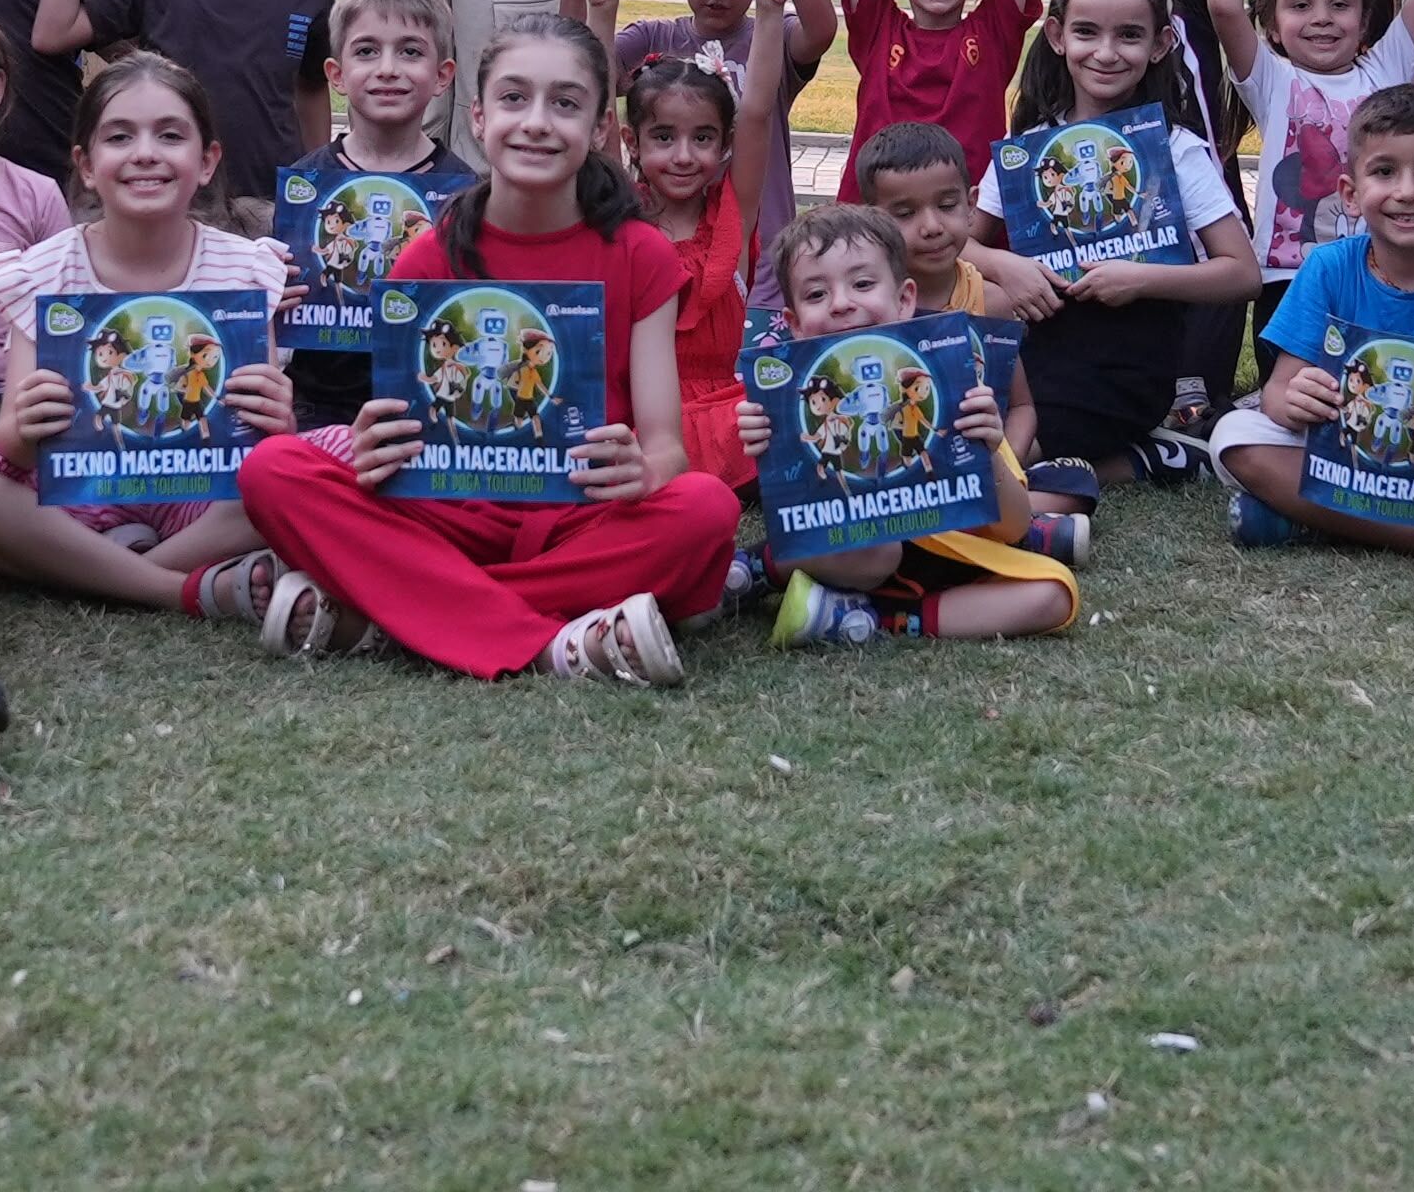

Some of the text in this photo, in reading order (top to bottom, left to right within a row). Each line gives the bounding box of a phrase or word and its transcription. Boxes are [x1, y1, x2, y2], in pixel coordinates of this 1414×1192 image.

[1075, 225, 1179, 263] MACERACILAR
[284, 304, 336, 325] TEKNO
[50, 451, 117, 478] TEKNO
[1309, 454, 1350, 488] TEKNO
[778, 474, 982, 533] TEKNO MACERACILAR
